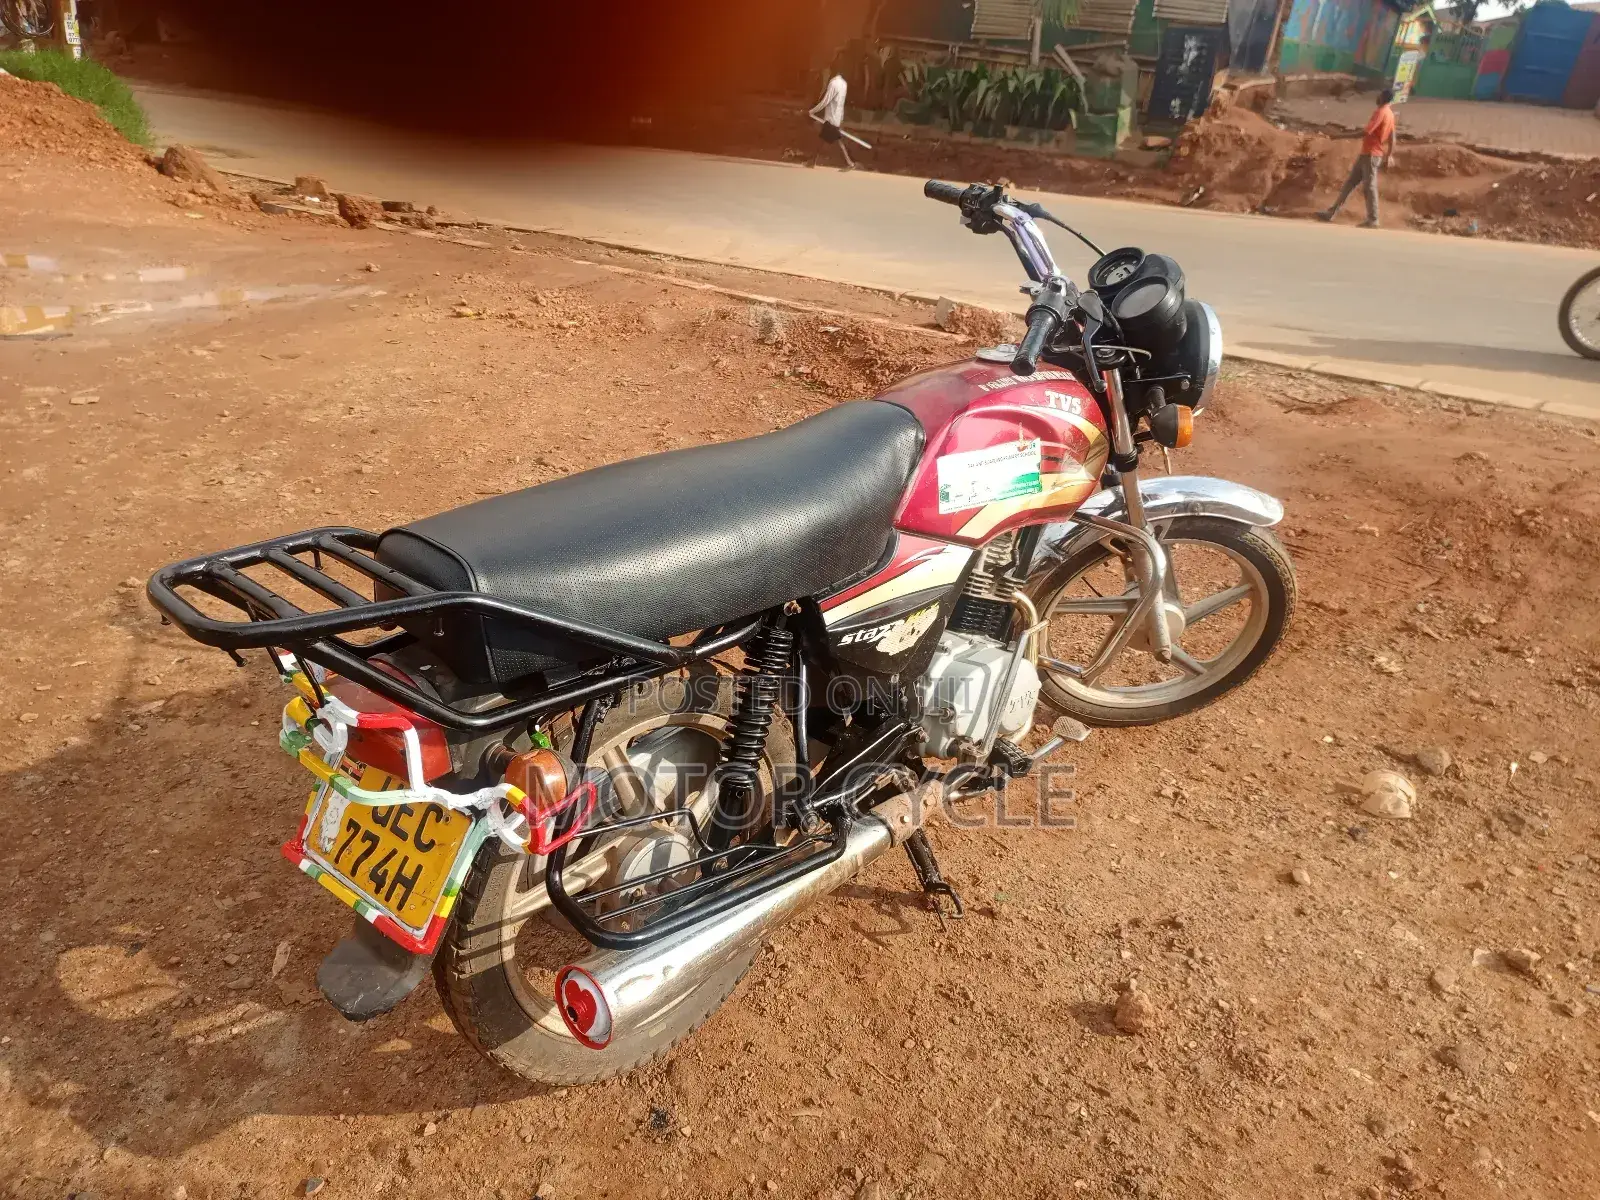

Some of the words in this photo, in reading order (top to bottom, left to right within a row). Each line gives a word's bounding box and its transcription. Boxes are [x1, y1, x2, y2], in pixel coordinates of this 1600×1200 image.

[1044, 390, 1082, 415] TVS
[371, 775, 444, 853] UEC
[333, 817, 424, 912] 774H
